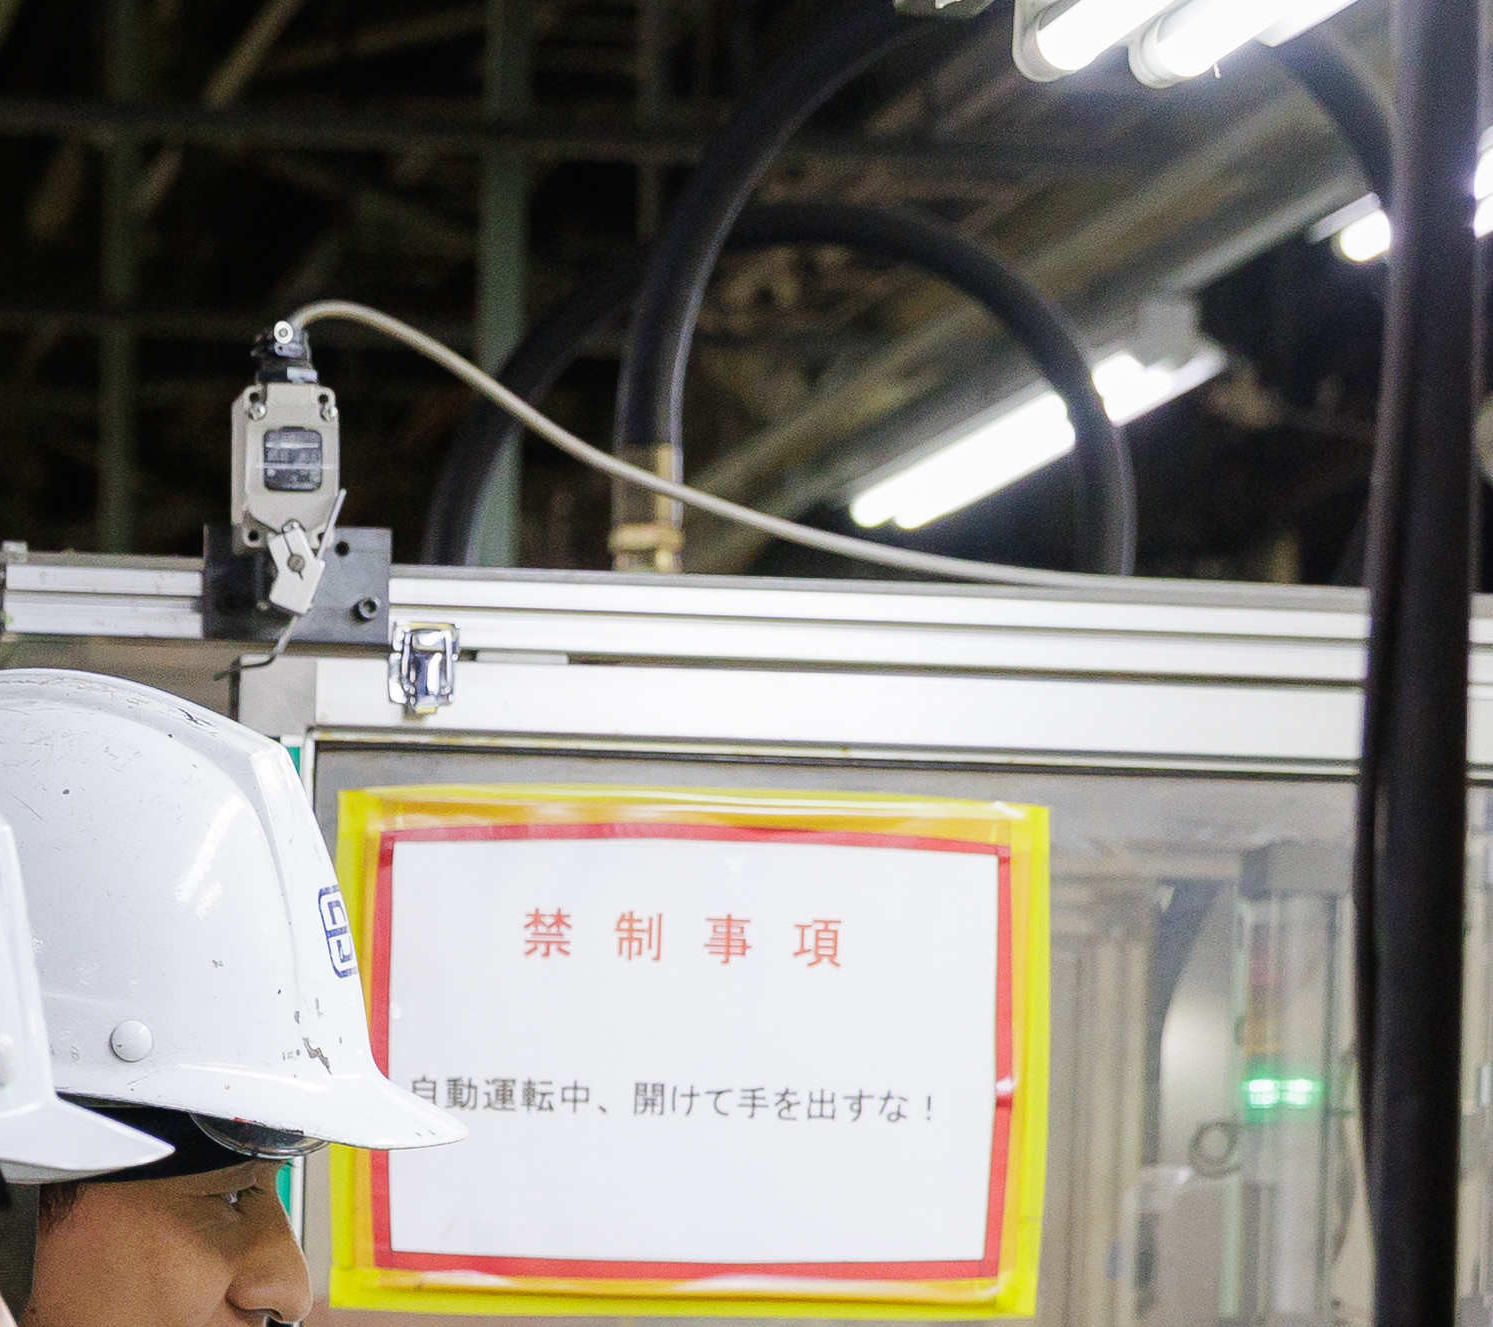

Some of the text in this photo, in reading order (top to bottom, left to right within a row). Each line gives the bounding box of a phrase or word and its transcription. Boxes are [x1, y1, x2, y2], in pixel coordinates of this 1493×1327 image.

[523, 907, 842, 968] 禁制事項
[411, 1075, 932, 1123] 自動運転中、開けて手を出すな！
